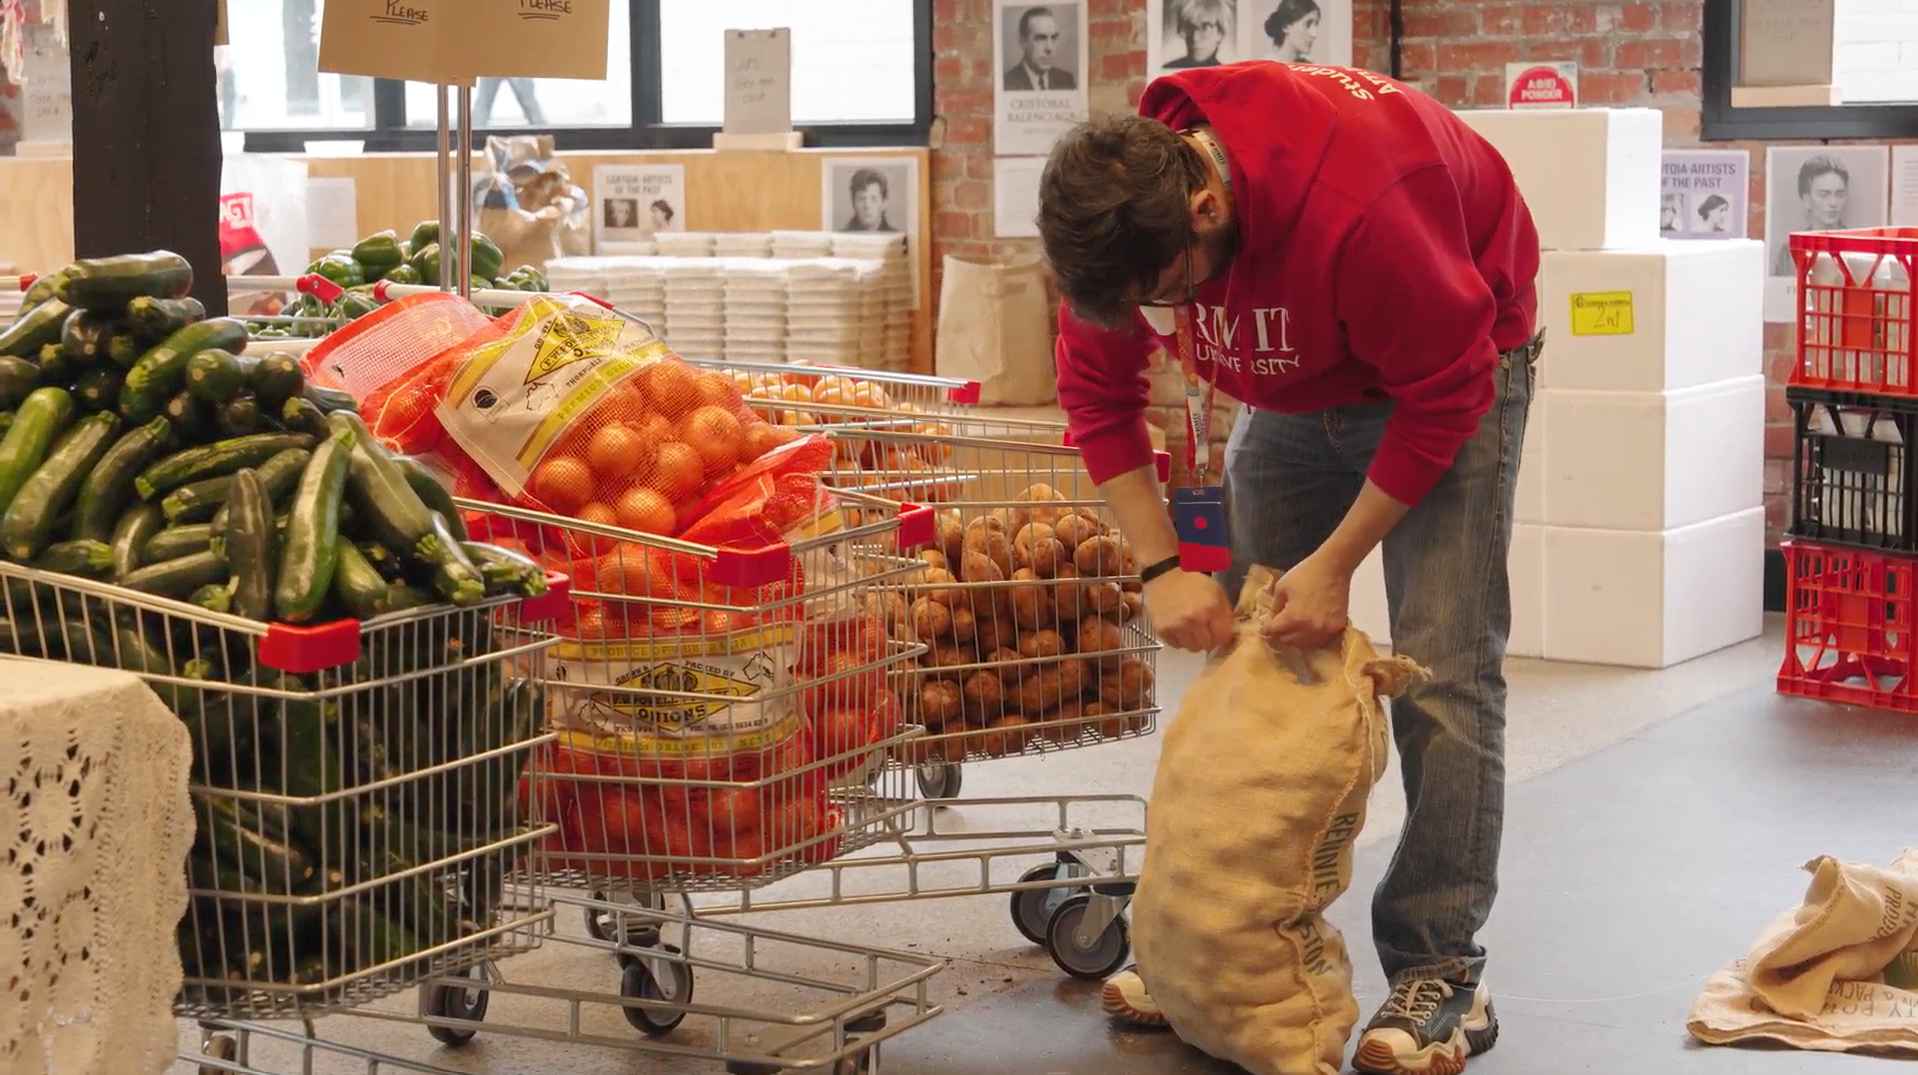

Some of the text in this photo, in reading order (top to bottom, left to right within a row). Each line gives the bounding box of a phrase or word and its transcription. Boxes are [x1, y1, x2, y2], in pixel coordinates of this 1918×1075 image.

[386, 0, 428, 21] PLEASE
[1691, 163, 1736, 175] ARTISTS
[1673, 177, 1690, 188] THE
[1694, 177, 1722, 188] PAST
[638, 704, 705, 722] ONIONS
